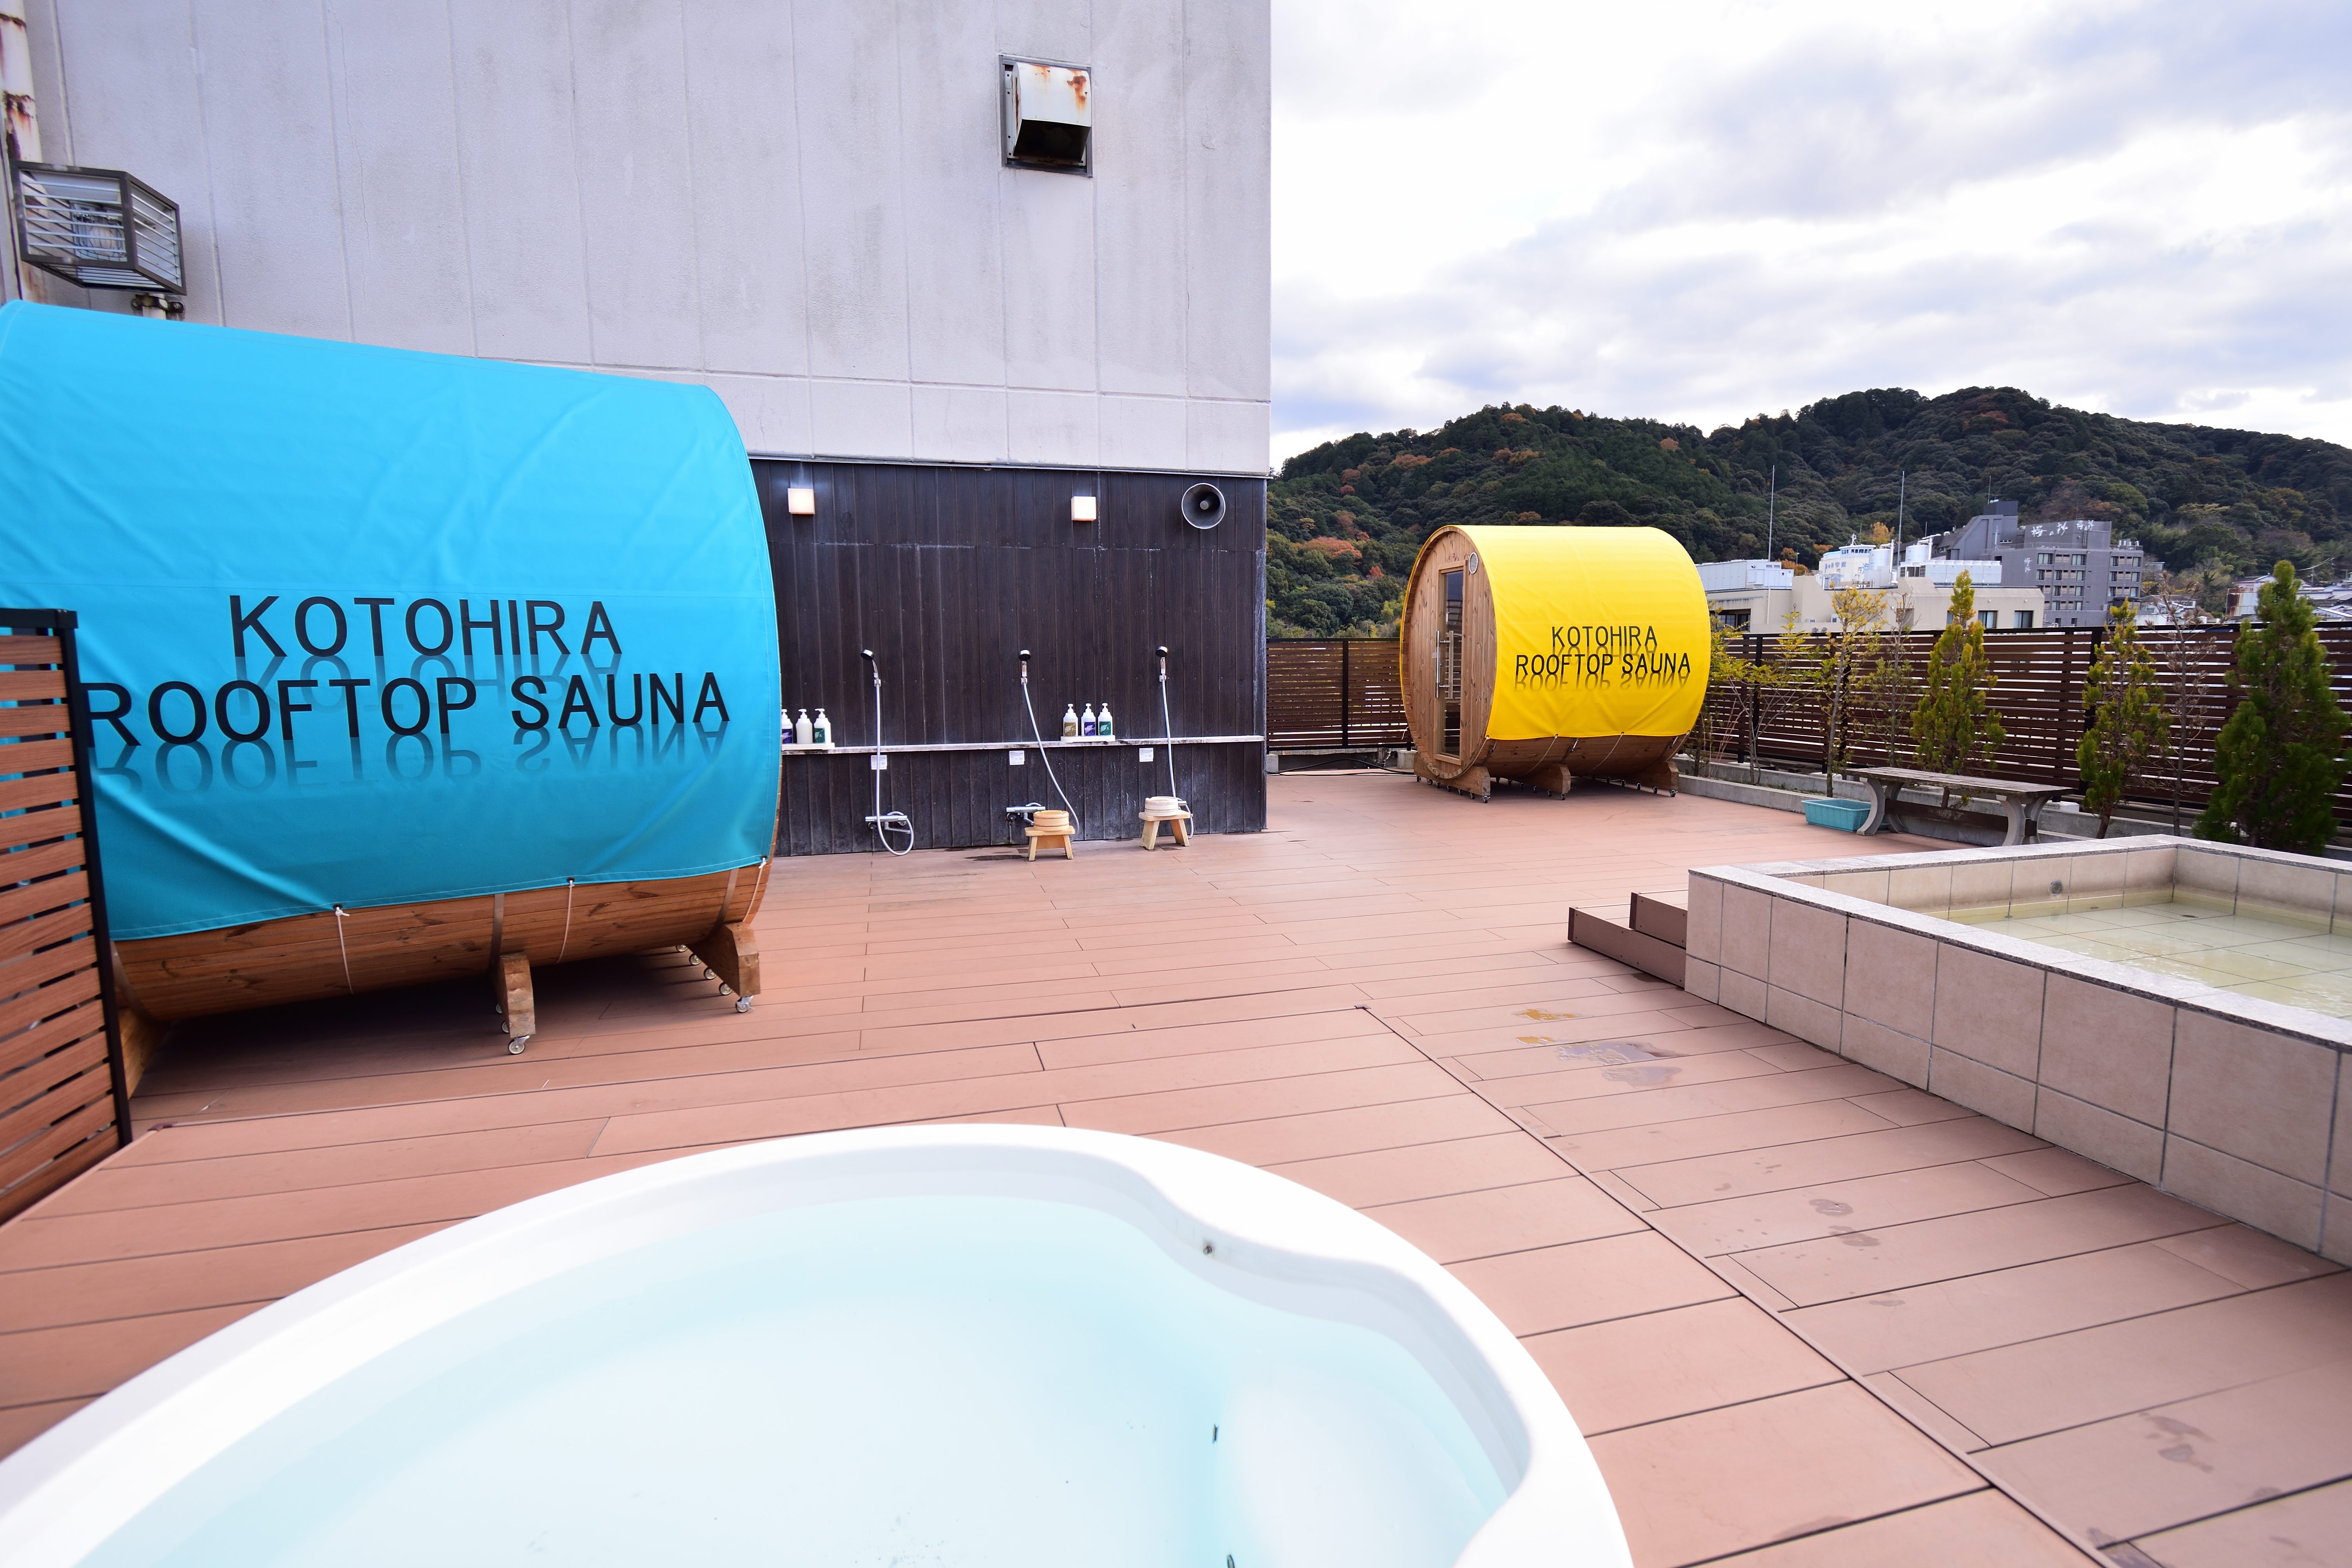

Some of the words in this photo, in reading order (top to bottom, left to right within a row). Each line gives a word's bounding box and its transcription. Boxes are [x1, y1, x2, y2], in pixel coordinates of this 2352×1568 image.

[229, 595, 622, 658] KOTOHIRA
[1552, 626, 1658, 647] KOTOHIRA
[1515, 653, 1613, 675] ROOFTOP
[1622, 653, 1690, 674] SAUNA
[80, 677, 476, 748] ROOFTOP
[511, 672, 730, 730] SAUNA
